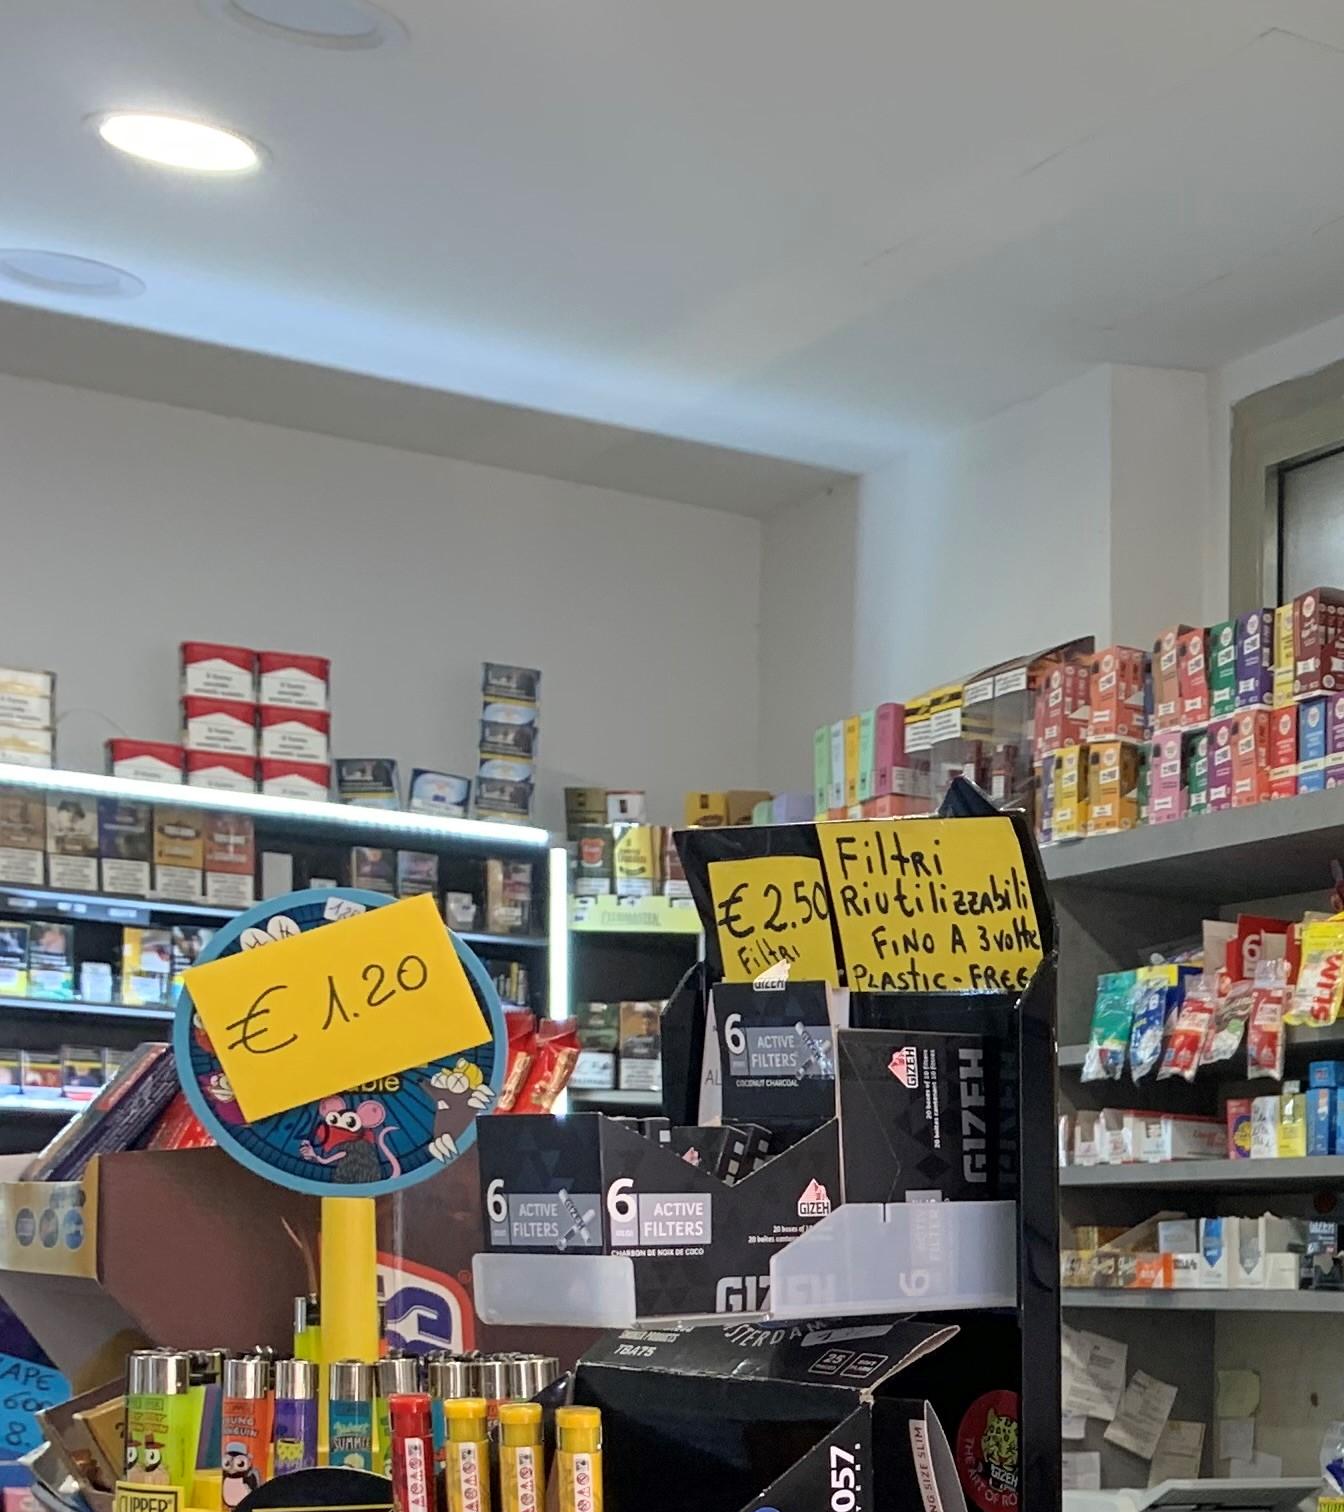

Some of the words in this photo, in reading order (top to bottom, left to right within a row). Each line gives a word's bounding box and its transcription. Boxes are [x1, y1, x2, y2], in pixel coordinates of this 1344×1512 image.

[836, 831, 944, 880] Filtri
[718, 882, 755, 938] €
[763, 880, 830, 934] 2.50
[951, 924, 967, 954] A
[978, 924, 991, 950] 3
[226, 985, 298, 1054] €
[322, 955, 428, 1030] 1.20
[1312, 950, 1344, 1022] SLIM
[724, 1012, 747, 1056] 6
[757, 1034, 795, 1050] ACTIVE
[752, 1052, 797, 1069] FILTERS
[959, 1048, 987, 1183] GIZEH
[607, 1177, 637, 1223] 6
[653, 1202, 704, 1216] ACTIVE
[799, 1202, 829, 1215] GIZEH
[644, 1221, 704, 1237] FILTERS
